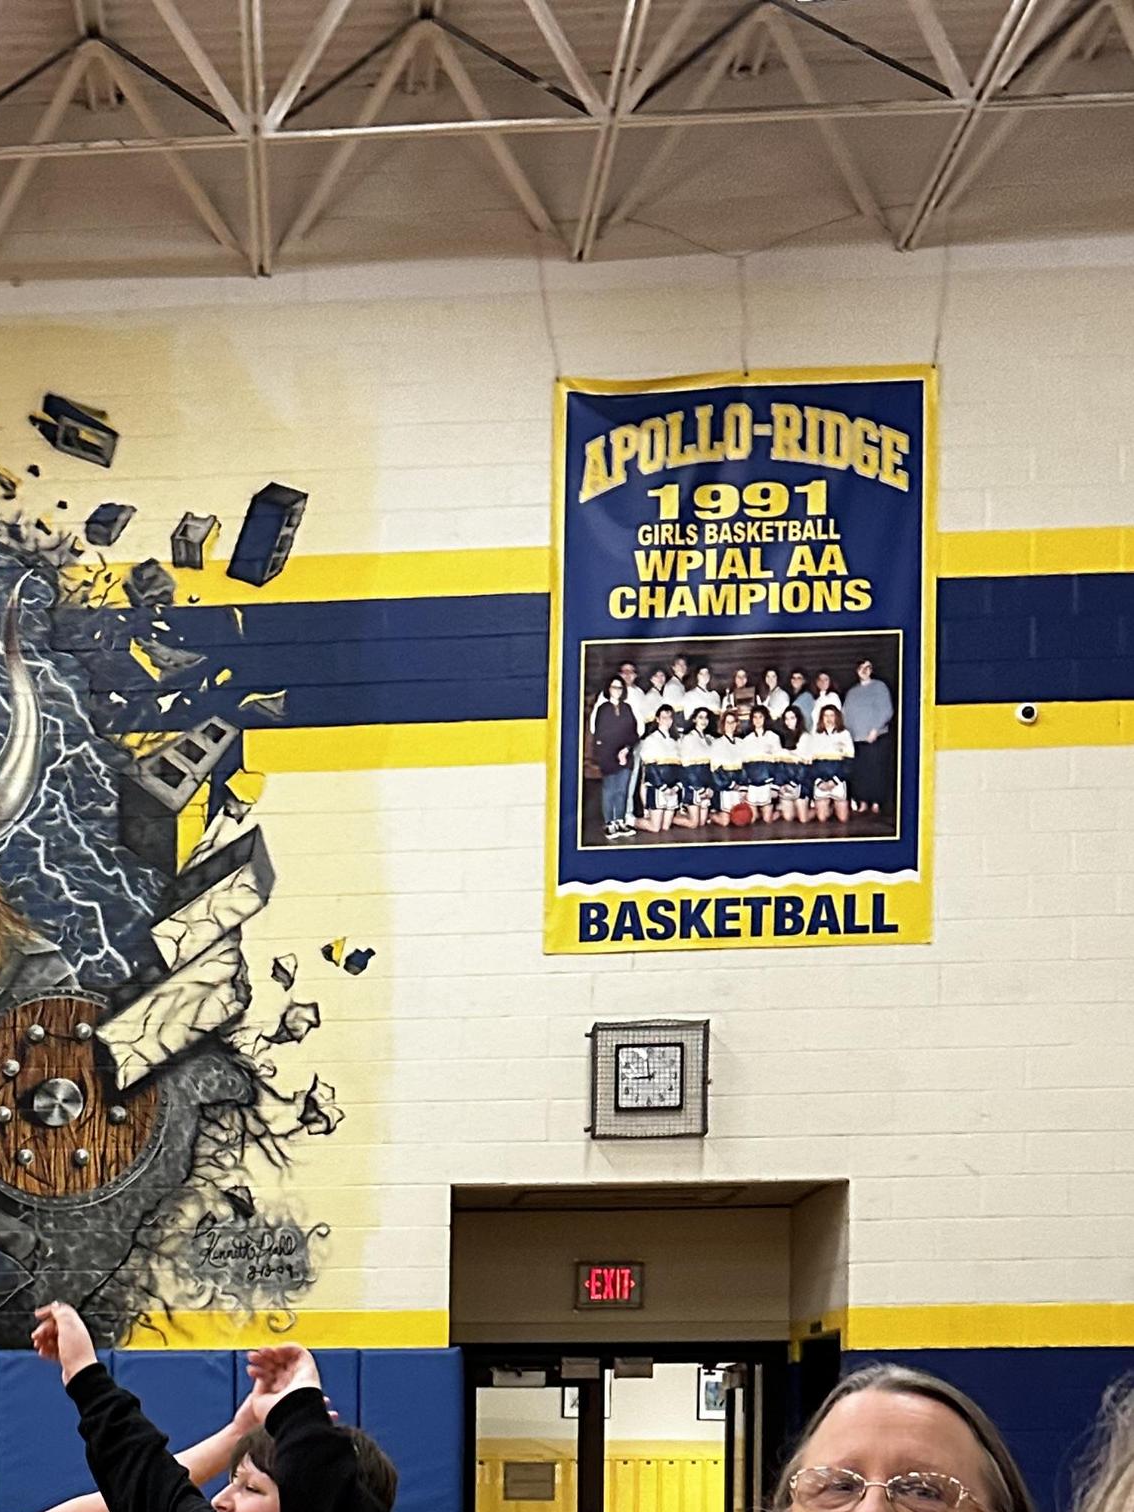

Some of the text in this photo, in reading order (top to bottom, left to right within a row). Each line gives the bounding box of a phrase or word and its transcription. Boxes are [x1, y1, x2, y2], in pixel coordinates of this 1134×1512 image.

[579, 403, 910, 501] APOLLO-RIDGE
[647, 480, 827, 520] 1991
[637, 519, 841, 545] GIRLS BASKETBALL
[634, 545, 848, 582] WPIAL AA
[608, 579, 872, 619] CHAMPIONS
[578, 893, 899, 943] BASKETBALL
[590, 1268, 631, 1300] EXIT
